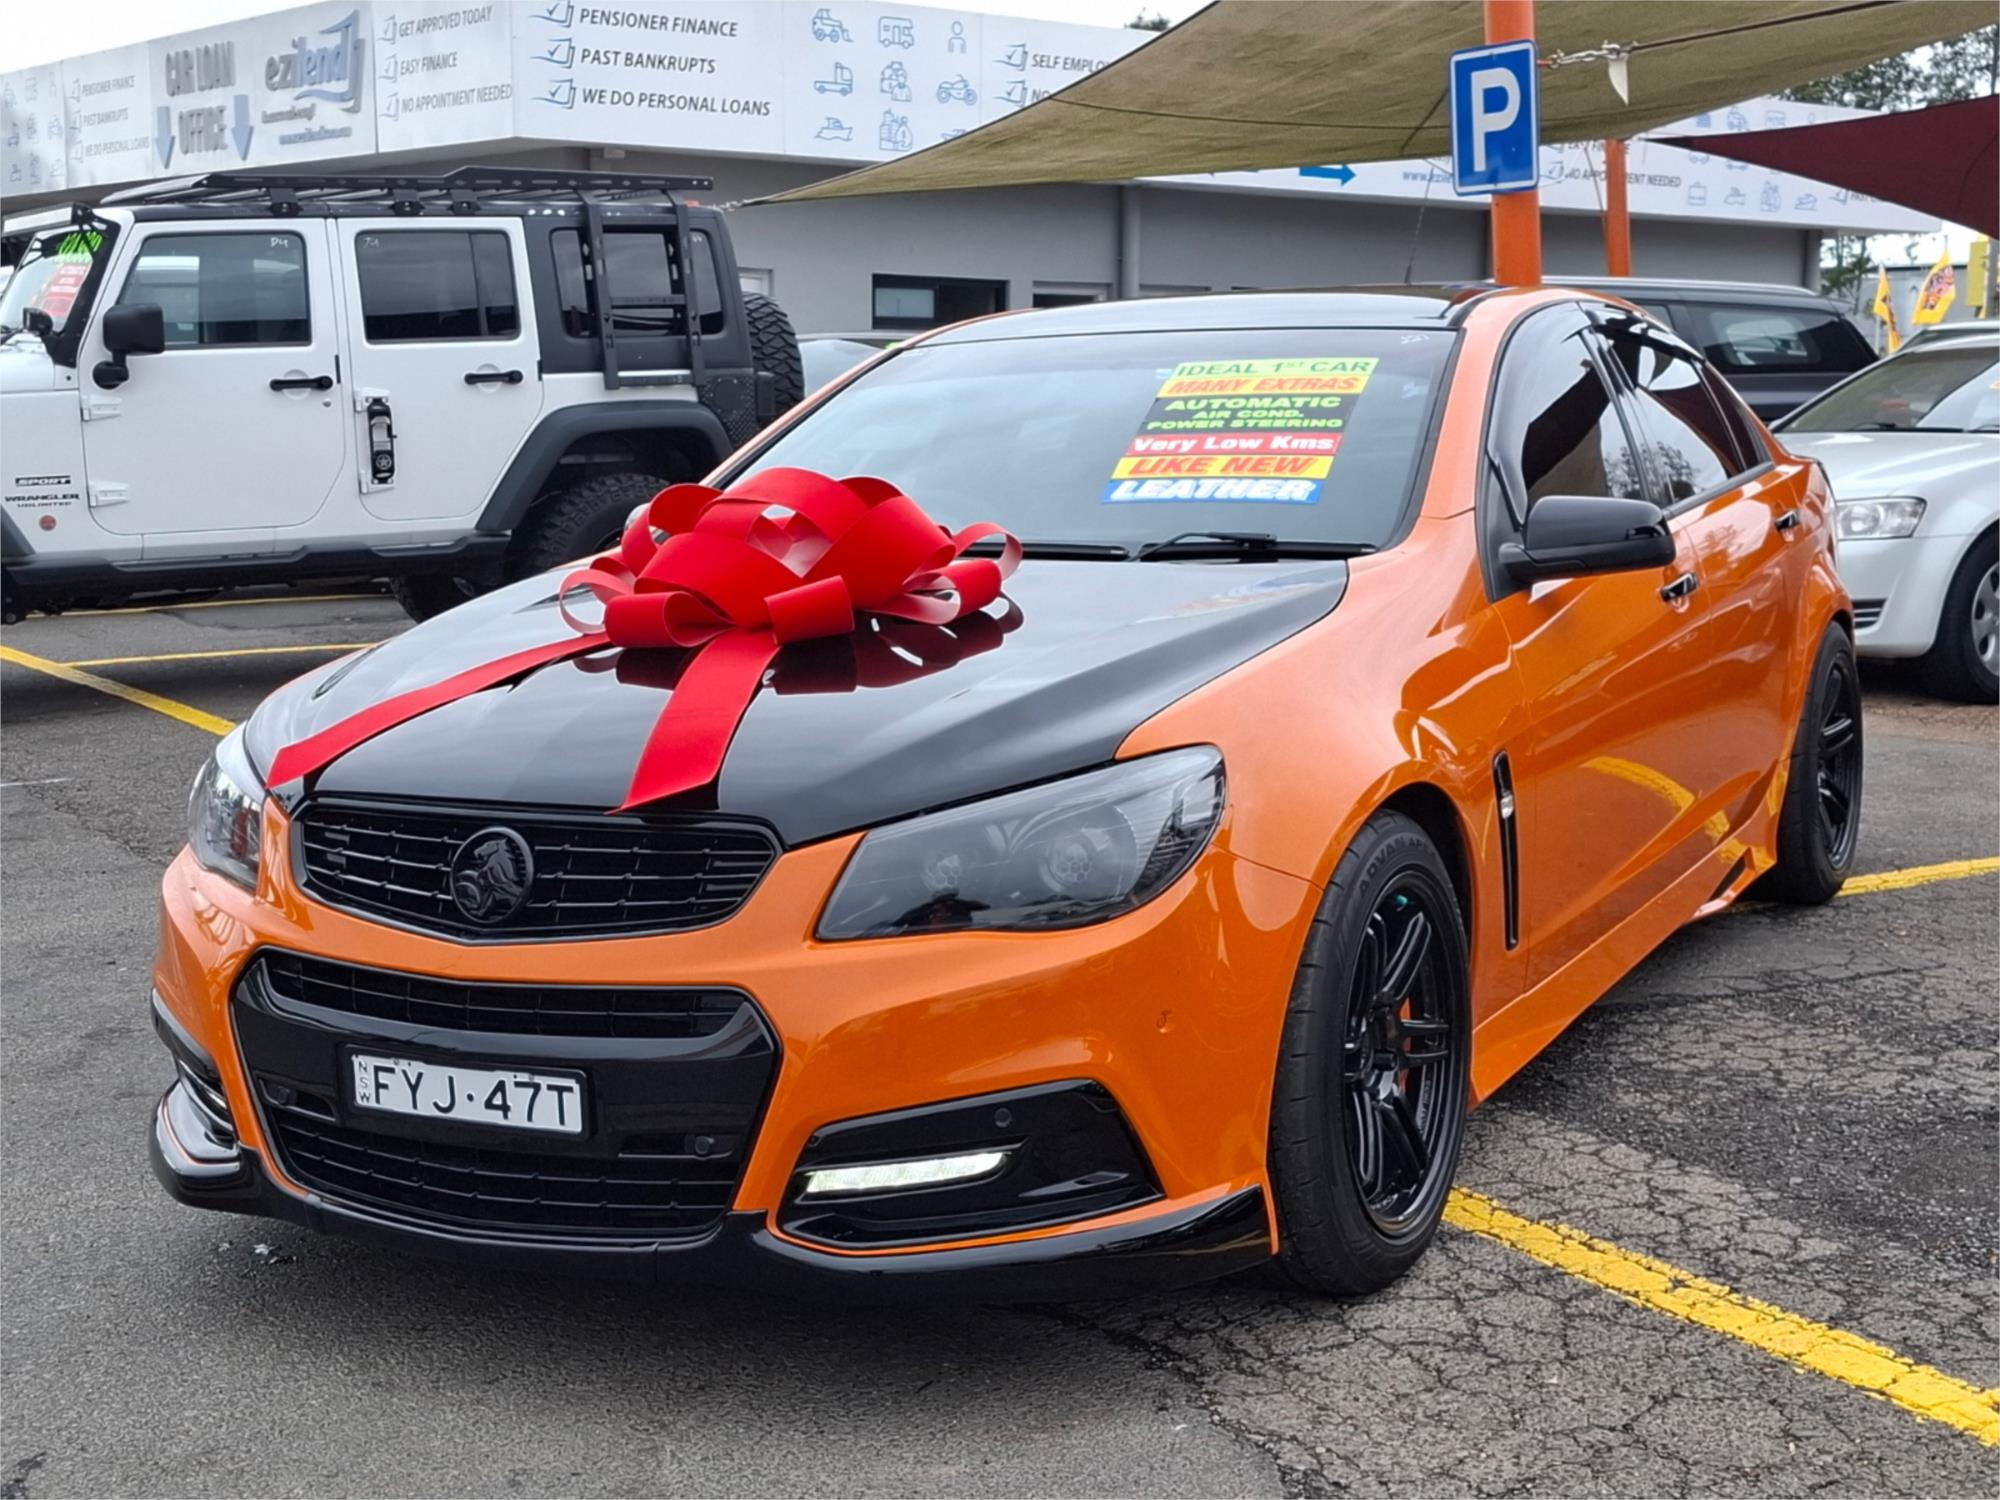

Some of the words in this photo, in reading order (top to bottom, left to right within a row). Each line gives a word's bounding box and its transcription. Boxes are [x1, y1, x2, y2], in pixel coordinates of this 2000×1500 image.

[399, 20, 415, 38] GET
[415, 12, 461, 35] APPROVED
[462, 5, 493, 27] TODAY
[579, 7, 669, 32] PENSIONER
[671, 16, 739, 37] FINANCE
[399, 58, 420, 77] EASY
[420, 51, 458, 73] FINANCE
[580, 48, 622, 67] PAST
[623, 51, 717, 74] BANKRUPTS
[1031, 53, 1061, 70] SELF
[1062, 56, 1109, 74] EMPLO
[164, 51, 196, 97] CAR
[400, 96, 414, 114] NO
[415, 87, 476, 112] APPOINTMENT
[476, 82, 512, 104] NEEDED
[582, 87, 607, 106] WE
[610, 89, 635, 107] DO
[637, 91, 718, 113] PERSONAL
[720, 98, 772, 117] LOANS
[1470, 67, 1521, 172] P
[1176, 362, 1259, 377] IDEAL
[1309, 361, 1372, 372] CAR
[1167, 378, 1251, 395] MANY
[1252, 376, 1361, 392] EXTRAS
[1164, 396, 1343, 411] AUTOMATIC
[1192, 410, 1232, 420] AIR
[1235, 409, 1305, 419] COND.
[1146, 420, 1225, 430] POWER
[1229, 418, 1344, 429] STEERING
[1133, 437, 1200, 453] Very
[1202, 435, 1265, 450] Low
[1268, 434, 1335, 450] Kms
[1127, 457, 1220, 476] LIKE
[1219, 456, 1320, 475] NEW
[4, 493, 80, 502] WRANGLER
[1109, 478, 1317, 501] LEATHER
